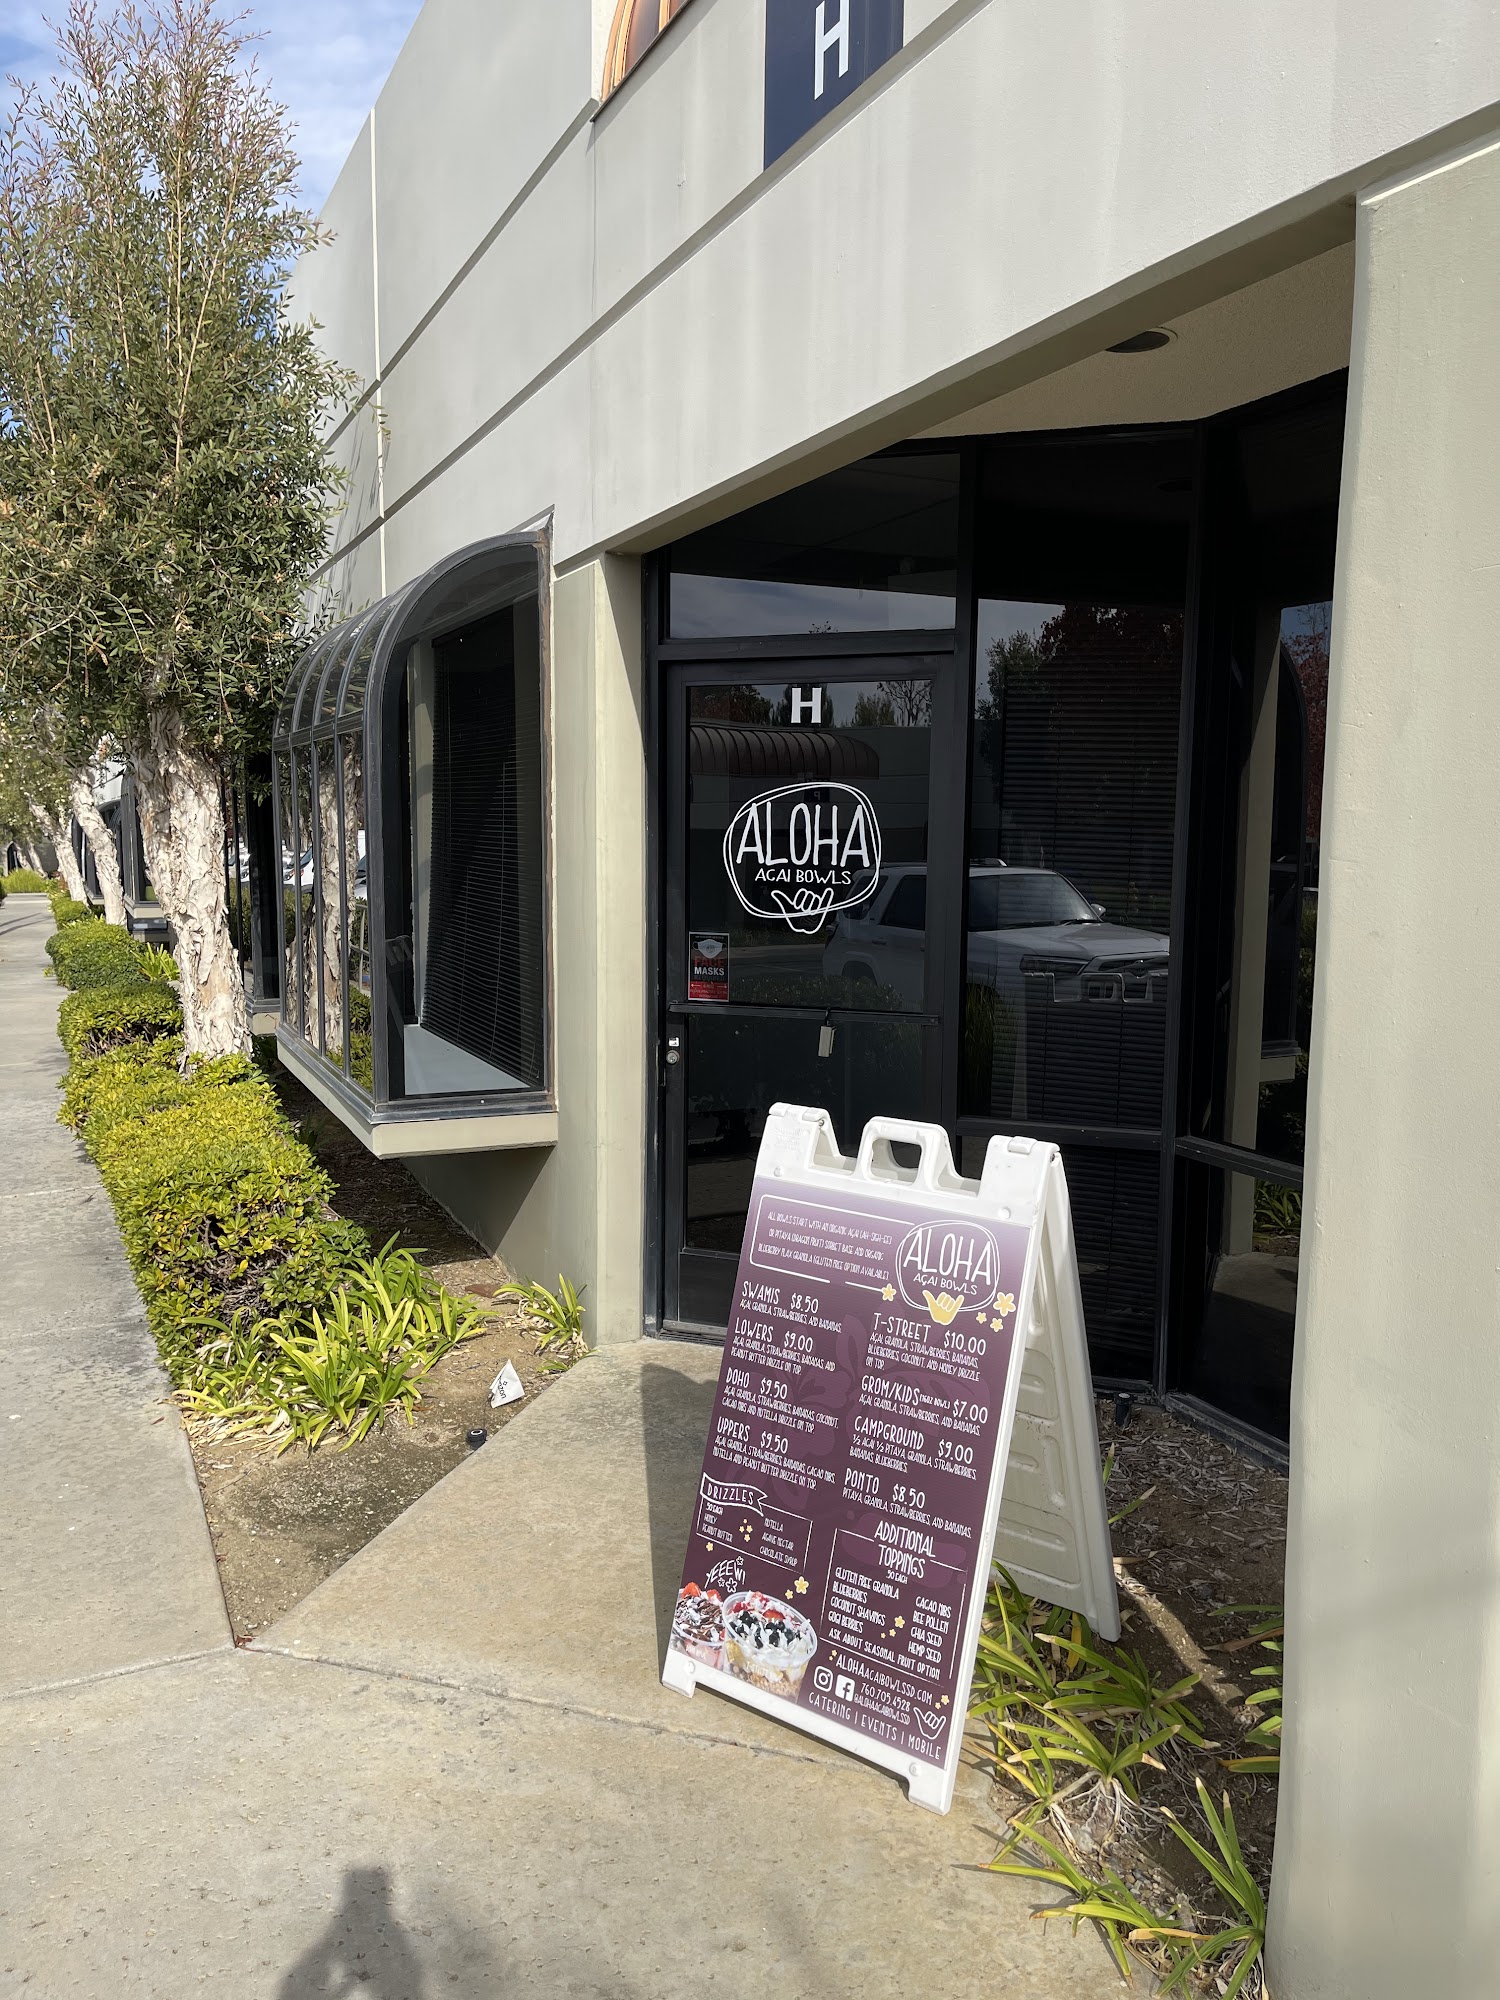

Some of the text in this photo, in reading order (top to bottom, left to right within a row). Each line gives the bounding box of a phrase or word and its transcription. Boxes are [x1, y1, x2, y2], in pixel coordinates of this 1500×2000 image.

[814, 0, 849, 100] H
[791, 687, 822, 724] H
[736, 802, 870, 868] ALOHA
[795, 869, 851, 885] BOWLS
[695, 967, 724, 976] MASKS
[903, 1227, 991, 1286] ALOHA
[742, 1281, 818, 1313] SWAMIS $8.50
[940, 1278, 977, 1295] BOWLS
[735, 1318, 813, 1352] LOWERS $9.00
[874, 1313, 986, 1355] T-STREET $10.00
[926, 1359, 938, 1370] AND
[938, 1362, 957, 1374] HONEY
[957, 1367, 980, 1381] DRIZZLE
[760, 1378, 787, 1399] $9.50
[862, 1375, 919, 1405] GROM/KIDS
[953, 1399, 988, 1423] $7.00
[717, 1417, 788, 1453] UPPERS $9.50
[855, 1416, 973, 1464] CAMPGROUND $9.00
[707, 1483, 754, 1506] DRIZZLES
[845, 1468, 925, 1508] PONTO $8.50
[875, 1522, 934, 1557] ADDITIONAL
[879, 1544, 925, 1578] TOPPINGS
[832, 1581, 867, 1603] BLUEBERRIES
[835, 1567, 899, 1599] GLUTEN FREE GRANOLA
[894, 1572, 907, 1584] EACH
[830, 1596, 885, 1626] COCONUT SHAVINGS
[912, 1610, 949, 1634] BEE POLLEN
[915, 1596, 951, 1618] CACAO NIBS
[841, 1615, 863, 1633] BERRIES
[910, 1627, 942, 1647] CHIA SEED
[828, 1628, 940, 1680] ASK ABOUT SEASONAL FRUIT OPTION
[908, 1641, 941, 1663] HEMP SEED
[809, 1692, 941, 1759] CATERING EVENTS MOBILE
